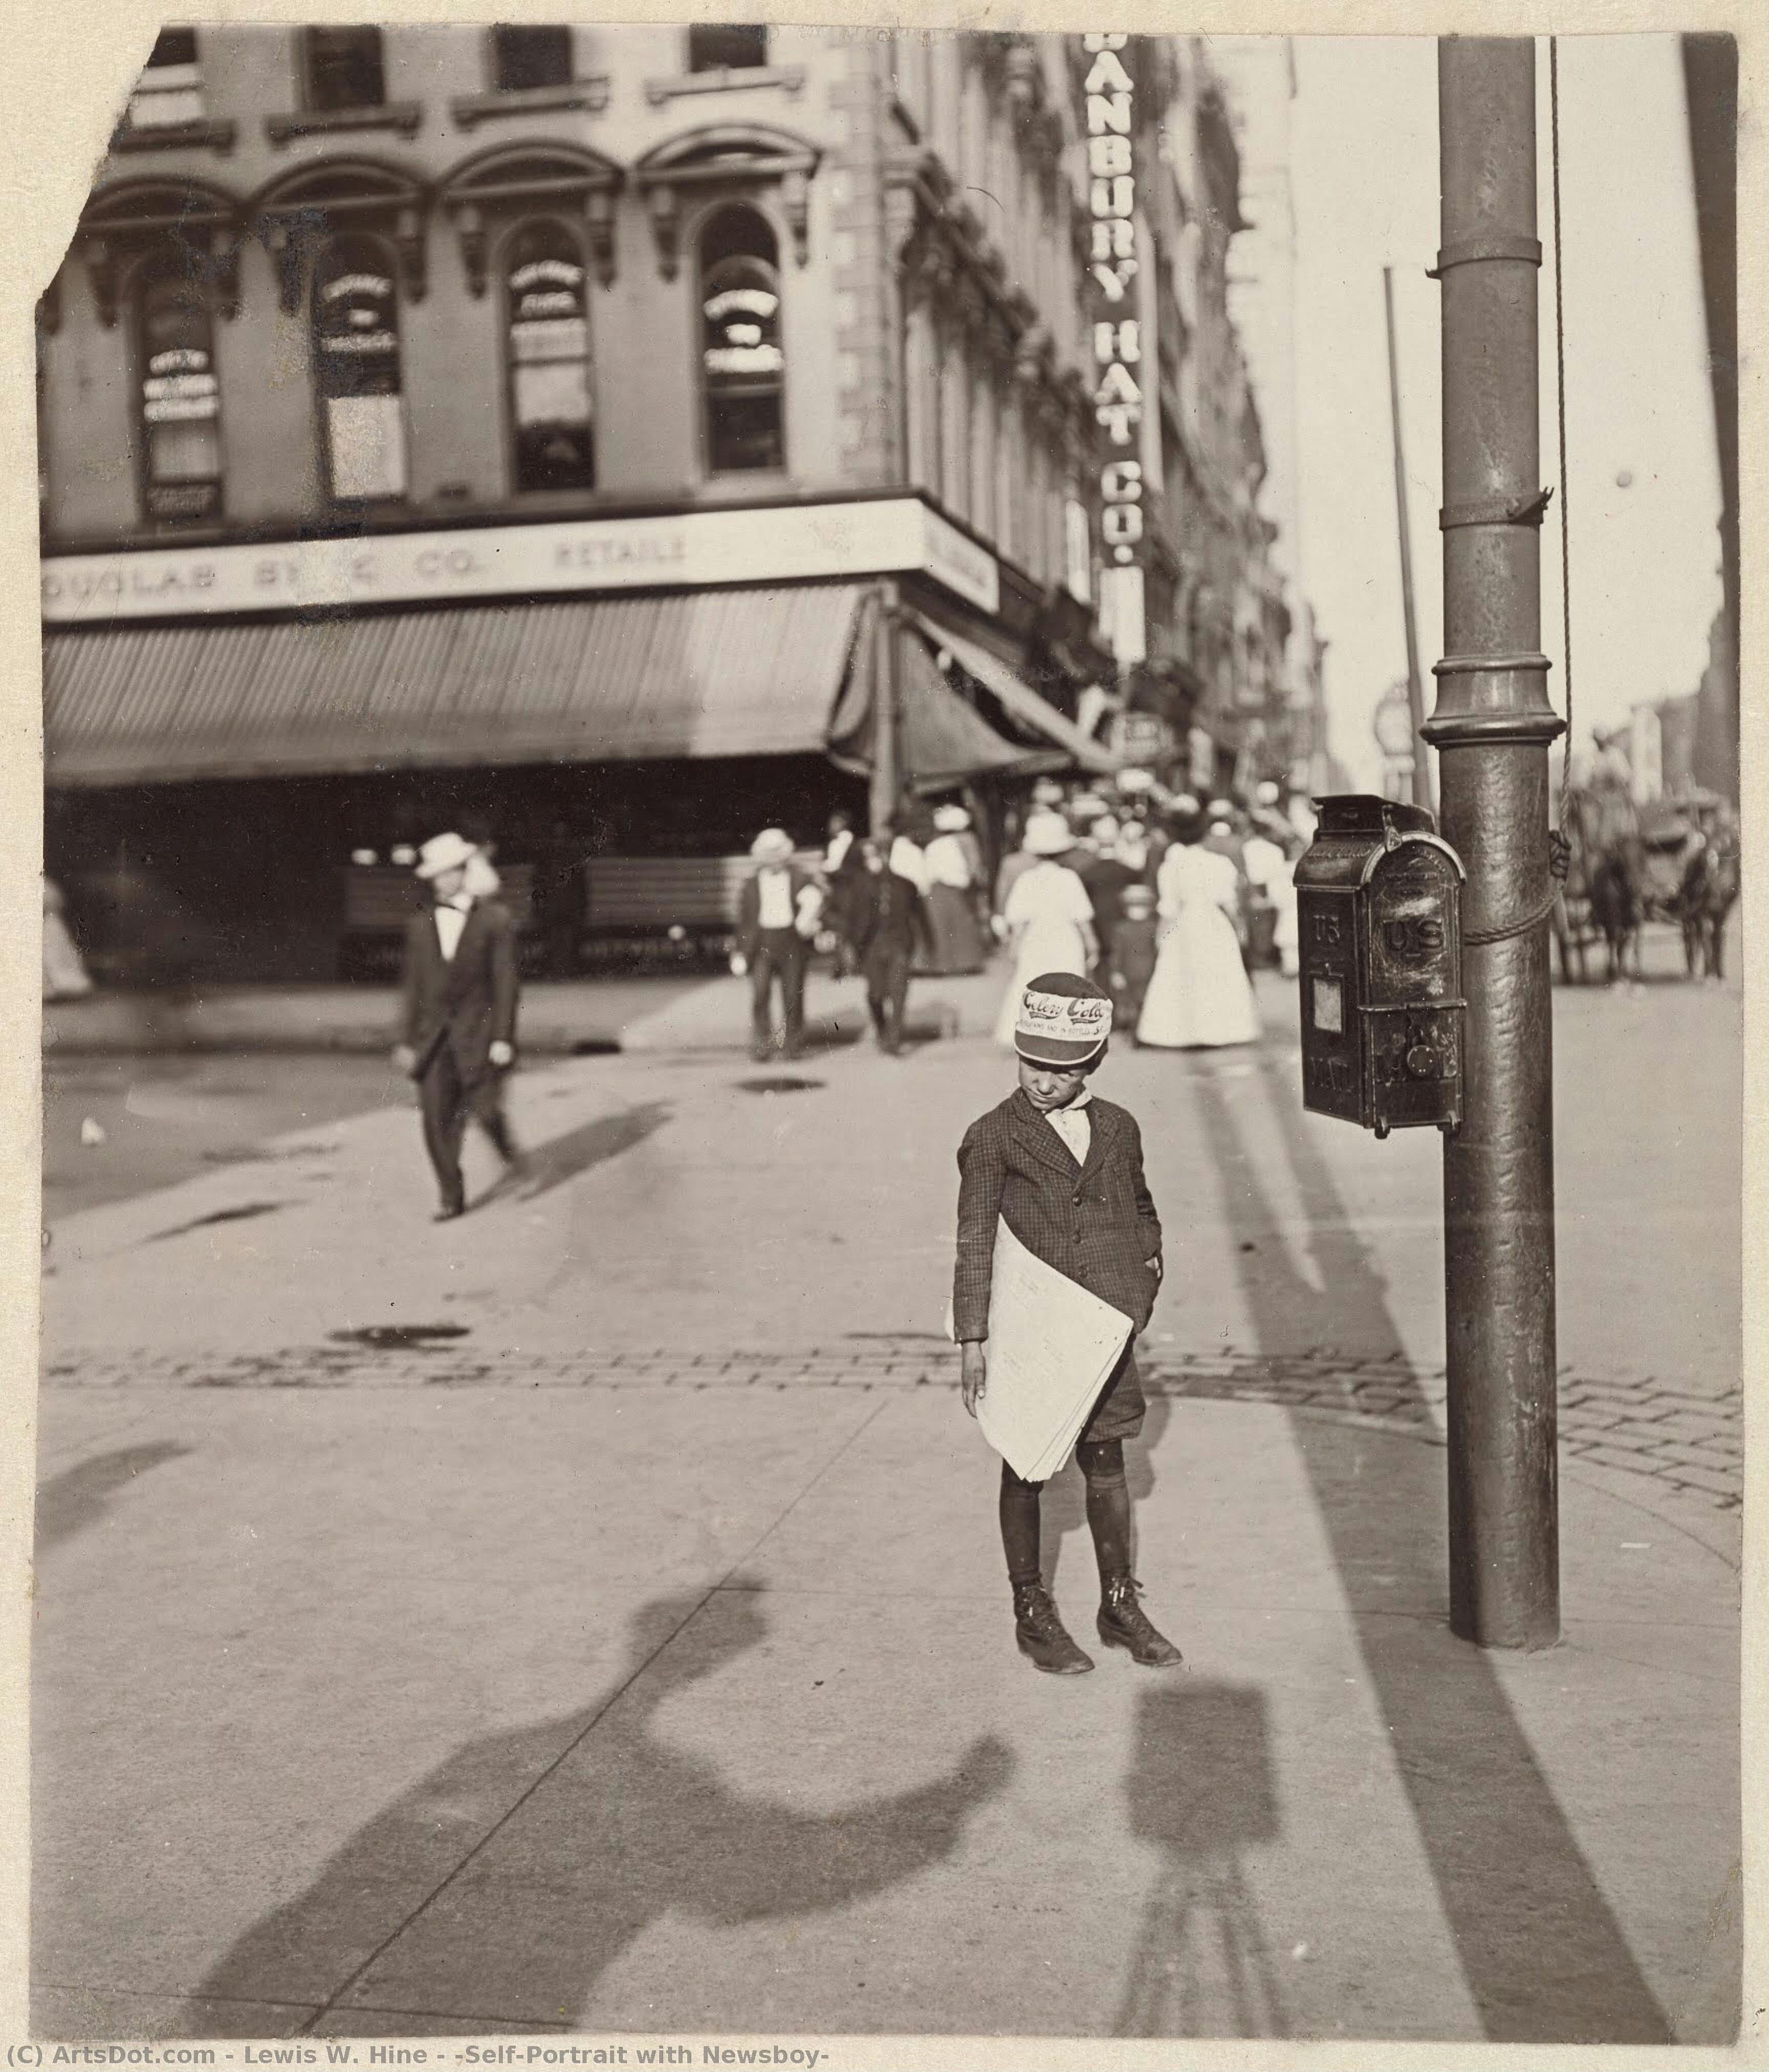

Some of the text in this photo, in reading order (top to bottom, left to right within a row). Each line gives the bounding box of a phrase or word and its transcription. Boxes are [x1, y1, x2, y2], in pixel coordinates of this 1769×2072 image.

[1094, 320, 1142, 446] HAT
[1101, 460, 1143, 563] CO.
[1067, 998, 1103, 1019] Cola
